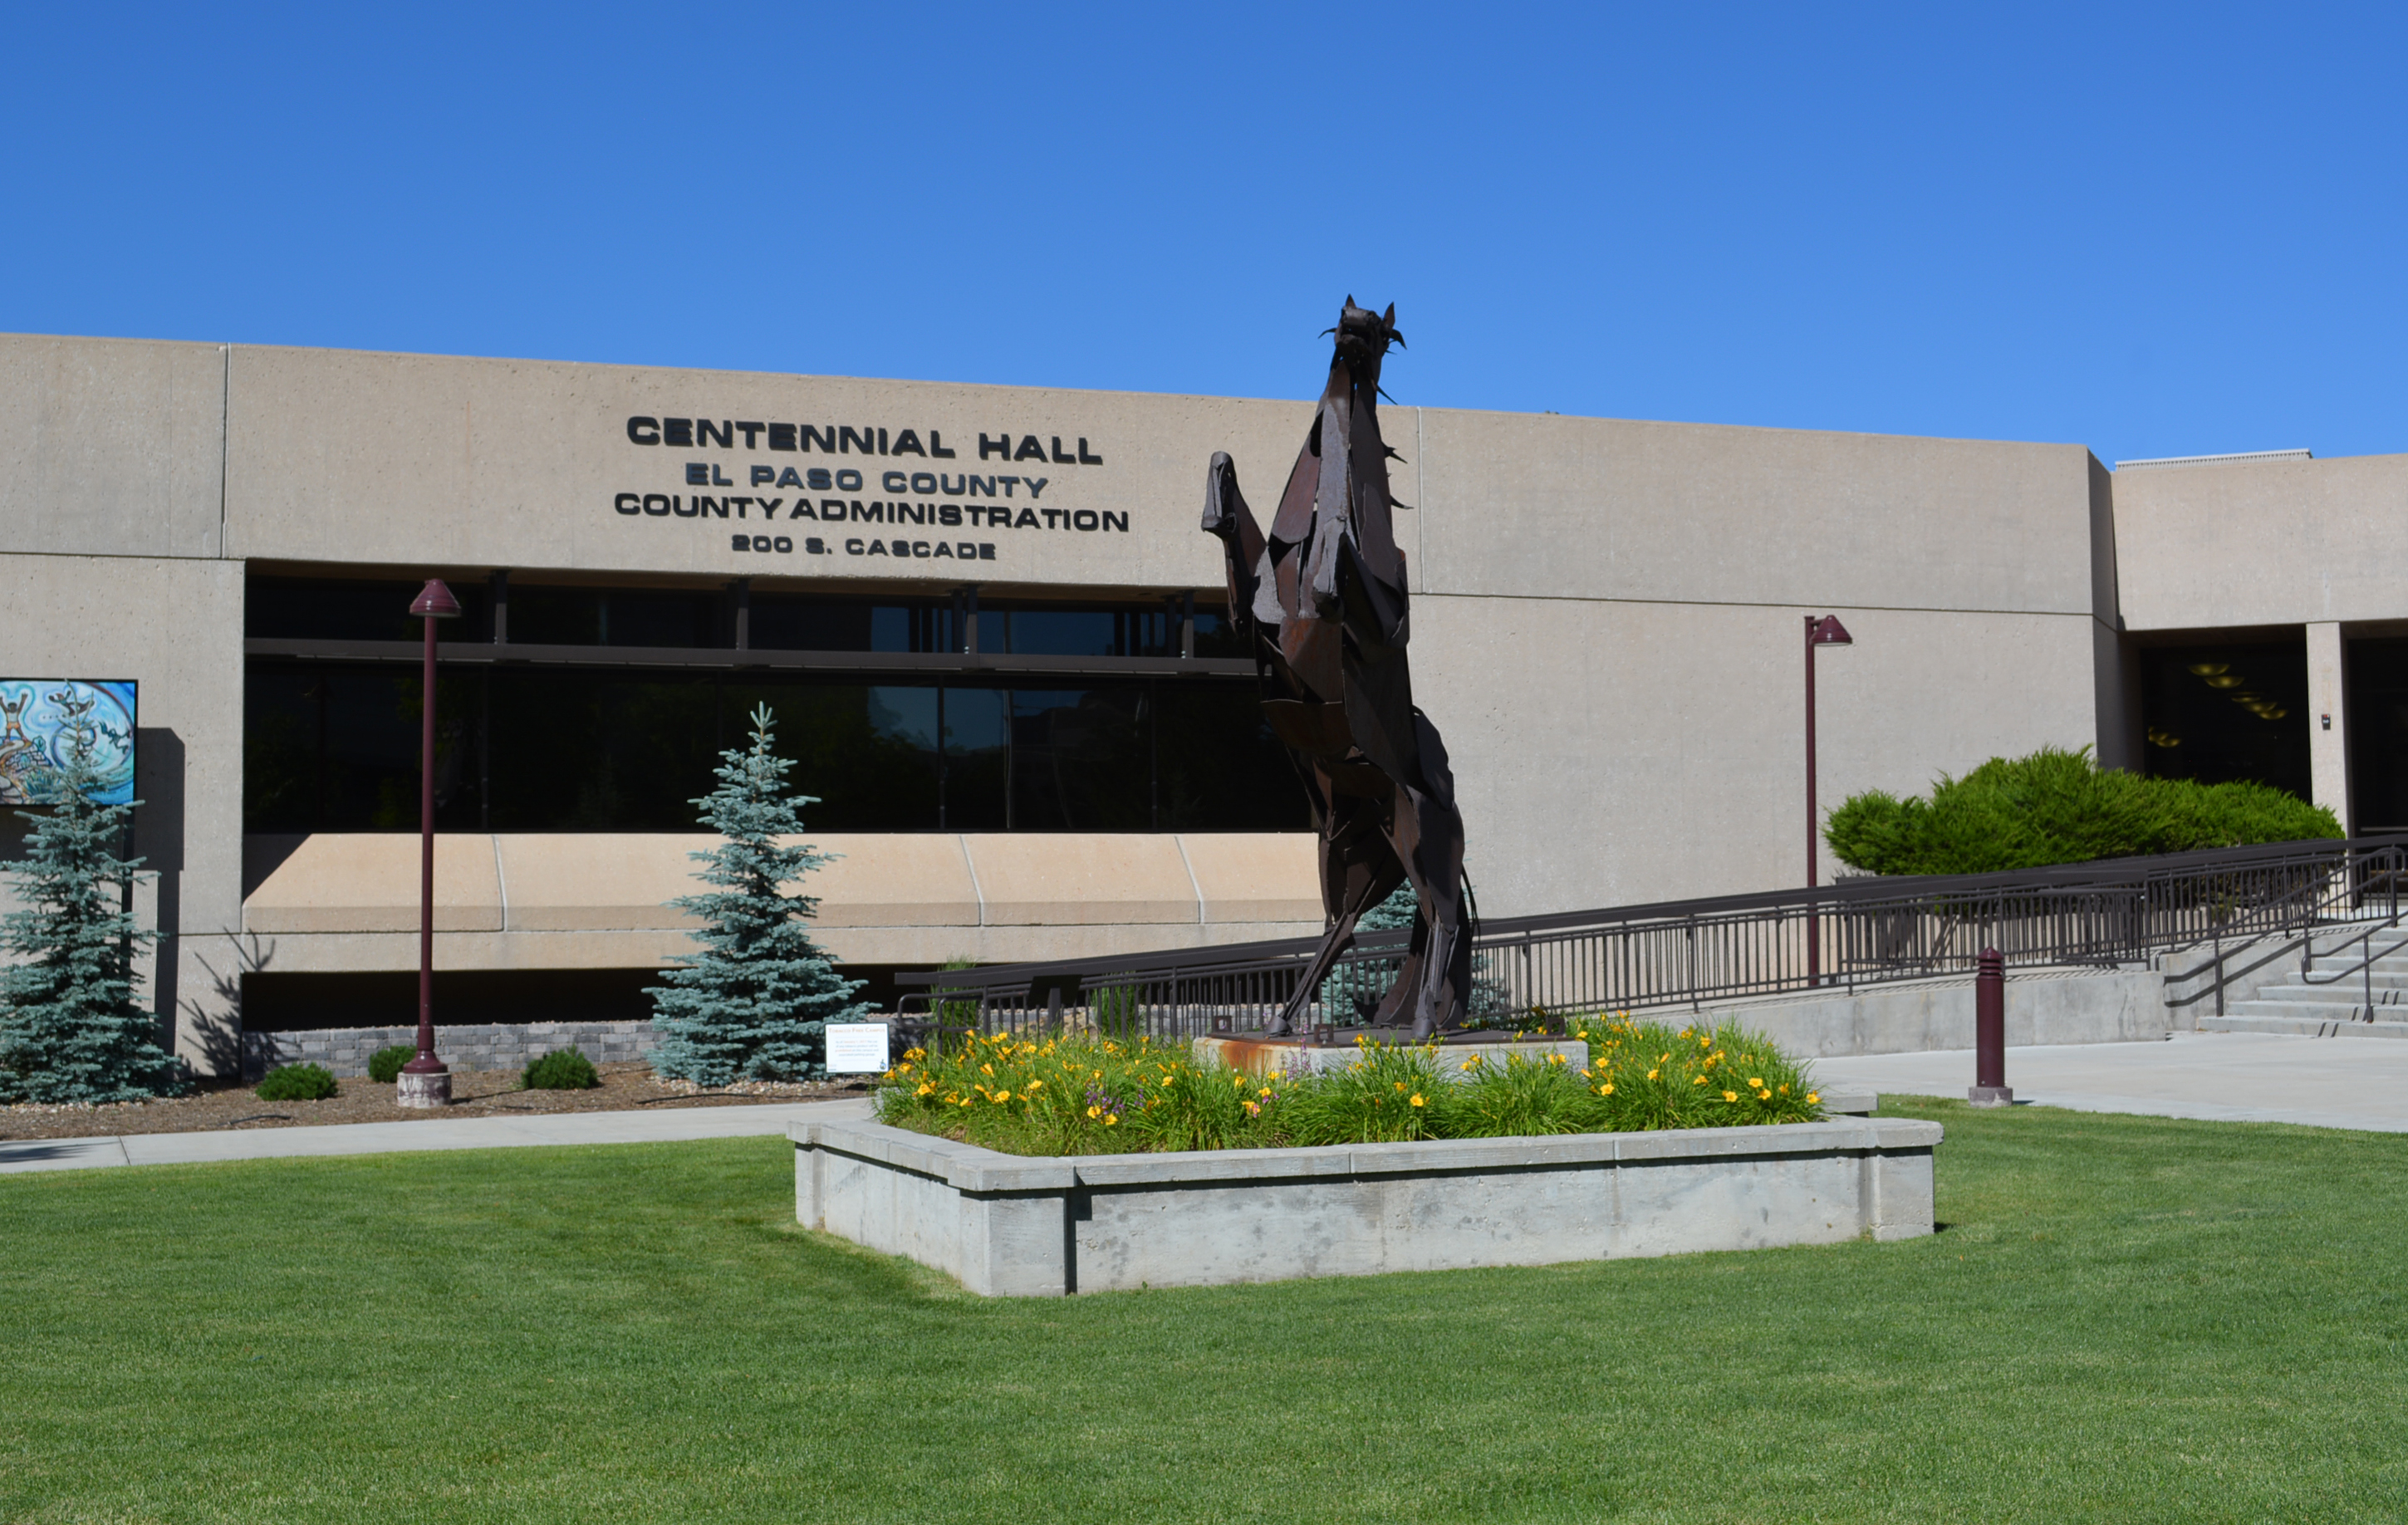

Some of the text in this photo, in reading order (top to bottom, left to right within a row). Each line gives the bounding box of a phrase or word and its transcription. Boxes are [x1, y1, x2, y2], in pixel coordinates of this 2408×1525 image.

[626, 415, 1103, 466] CENTENNIAL HALL
[685, 463, 1049, 499] EL PASO COUNTY
[614, 493, 1129, 532] COUNTY ADMINISTRATION
[732, 534, 996, 561] 200 S. CASCADE
